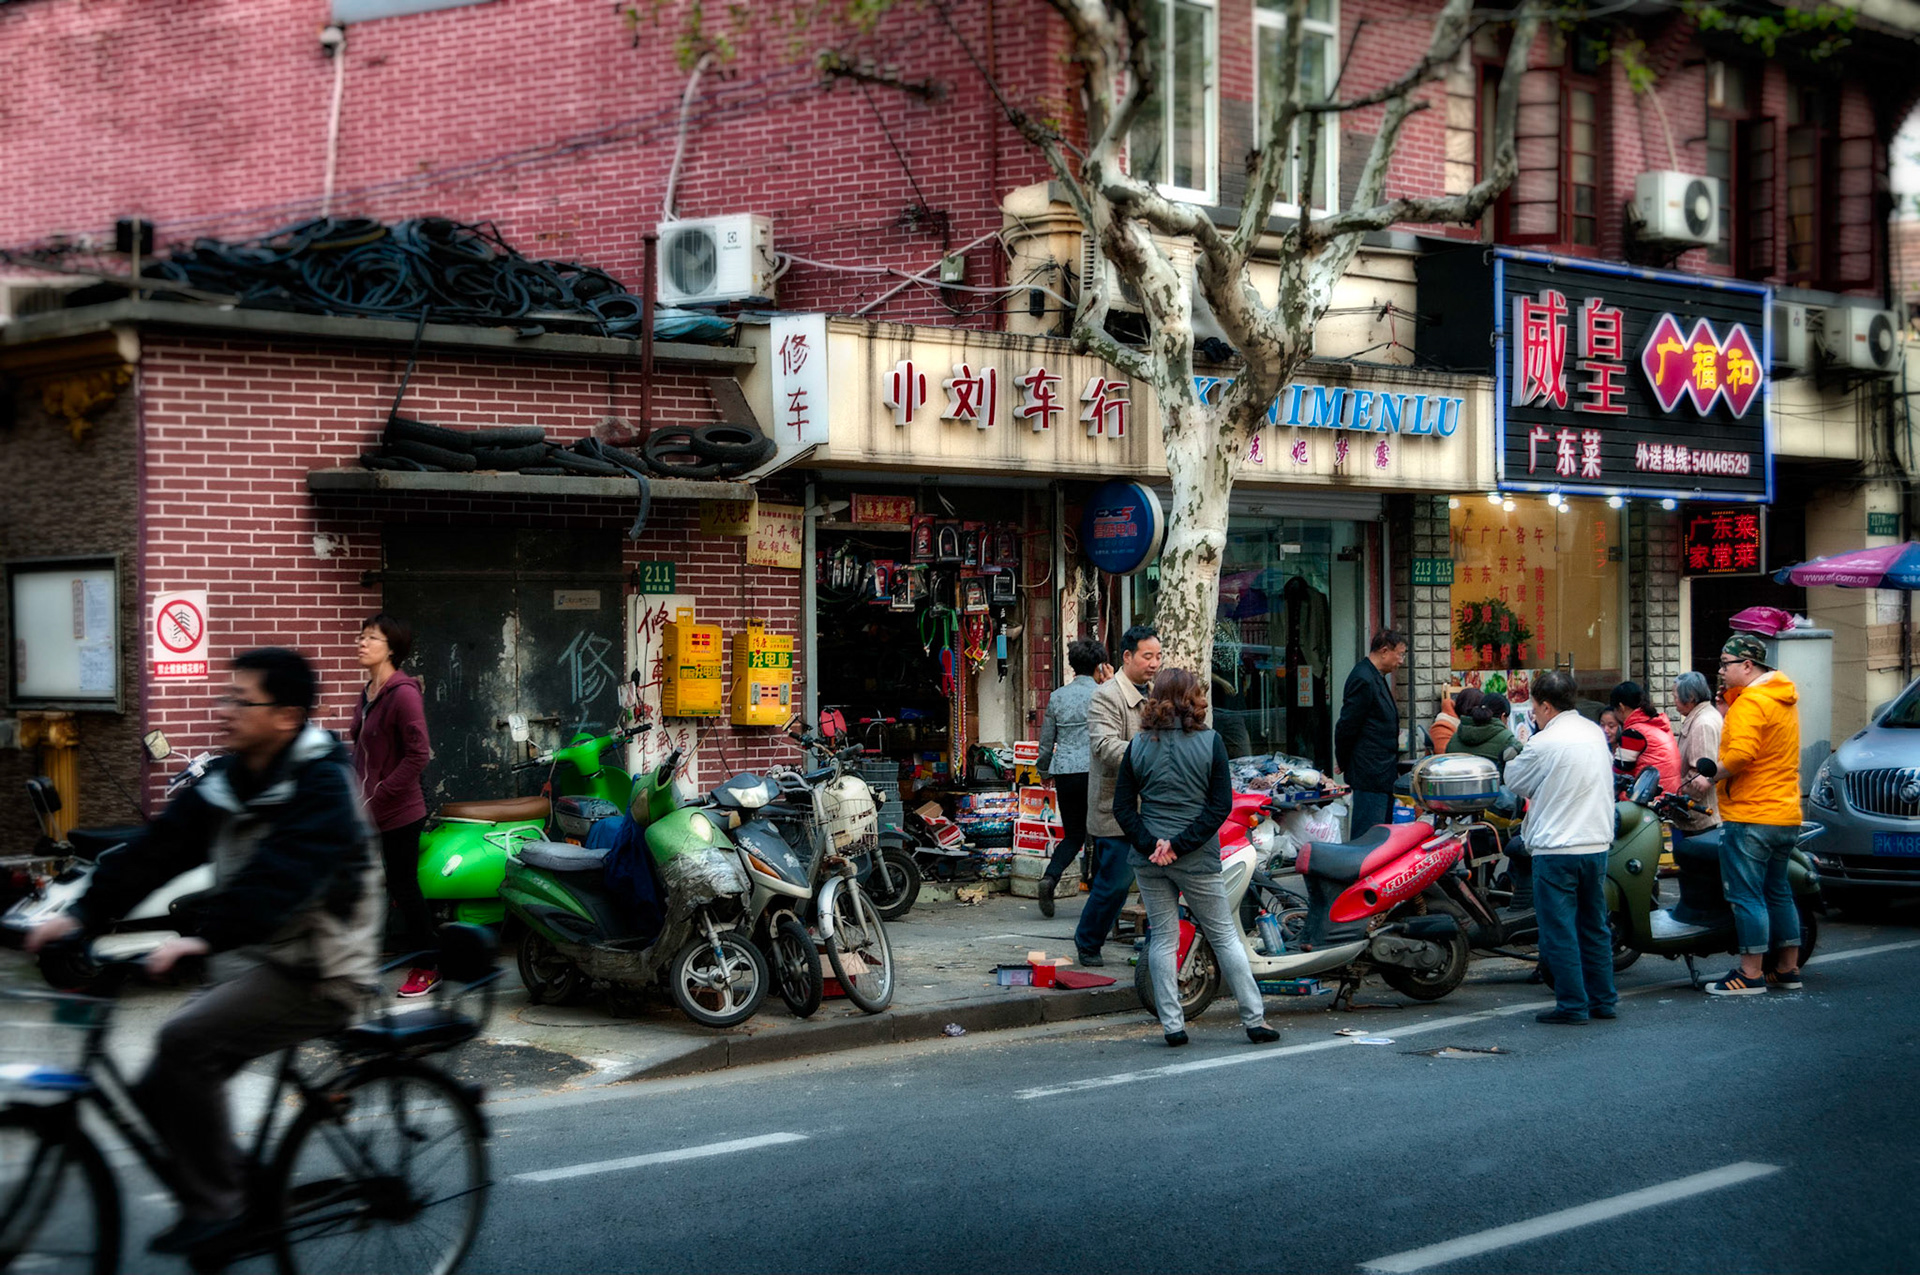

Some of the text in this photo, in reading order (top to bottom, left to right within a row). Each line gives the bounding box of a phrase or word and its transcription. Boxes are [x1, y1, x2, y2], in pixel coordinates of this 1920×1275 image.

[1513, 289, 1628, 415] 威皇
[1655, 337, 1754, 395] 广福和
[779, 333, 810, 442] 修车
[884, 359, 1131, 439] 小刘车行
[1190, 376, 1464, 437] KIMENLU
[1249, 433, 1390, 470] 克妮梦露
[1529, 425, 1601, 478] 广东菜
[756, 523, 801, 541] 门开锁
[1689, 514, 1759, 542] 广东菜
[644, 565, 671, 583] 211
[1414, 562, 1431, 575] 213
[1436, 562, 1452, 575] 215
[1688, 542, 1758, 570] 家常菜
